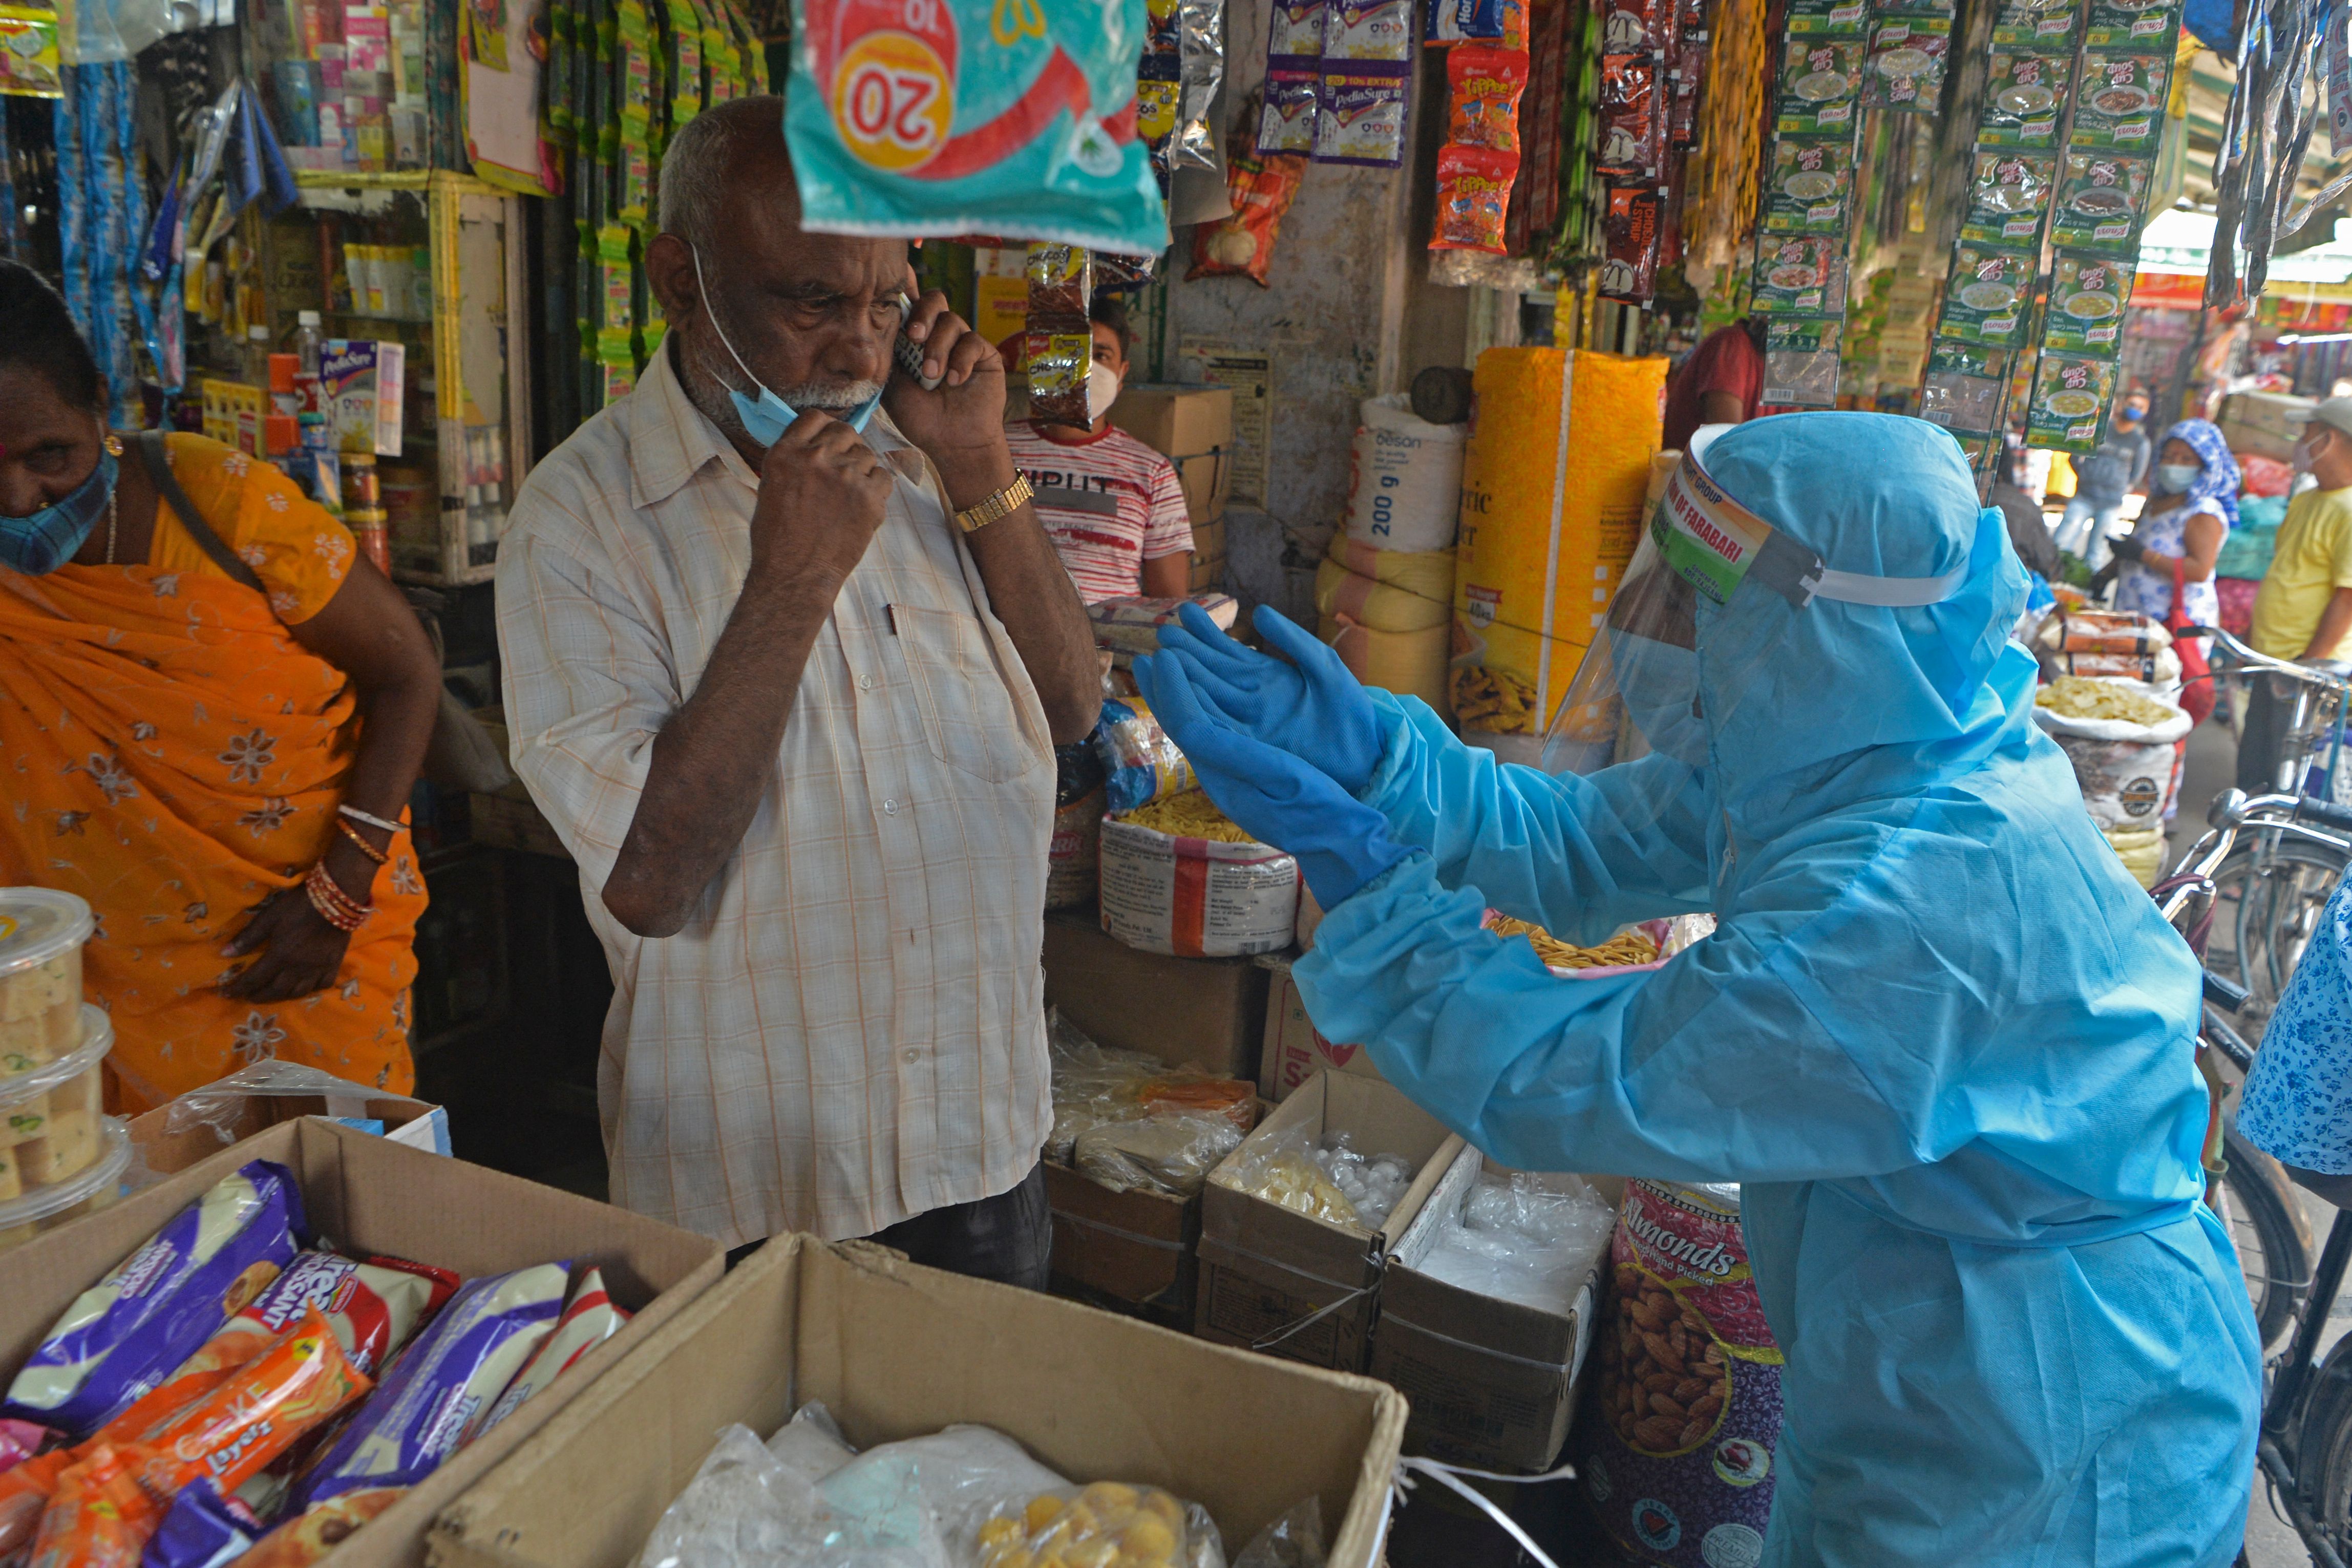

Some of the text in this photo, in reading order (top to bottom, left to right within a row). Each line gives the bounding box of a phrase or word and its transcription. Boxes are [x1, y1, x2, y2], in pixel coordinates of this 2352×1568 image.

[1831, 7, 1860, 18] Knorr
[2039, 19, 2070, 31] Knorr
[2133, 19, 2165, 31] Knorr
[1879, 30, 1908, 40] Knorr
[1808, 47, 1833, 61] Soup
[1812, 59, 1833, 72] Cup
[2013, 59, 2041, 74] Soup
[2107, 60, 2135, 74] Soup
[2017, 72, 2039, 84] Cup
[2112, 73, 2134, 84] Cup
[1335, 88, 1390, 107] PediaSure
[1890, 90, 1916, 102] Soup
[848, 64, 938, 146] 20
[1820, 109, 1848, 120] Knorr
[2023, 123, 2052, 133] Knorr
[2116, 124, 2147, 135] Knorr
[1797, 147, 1823, 162] Soup
[1801, 158, 1823, 171] Cup
[1998, 161, 2024, 175] Soup
[2001, 173, 2024, 184] Cup
[1809, 207, 1837, 218] Knorr
[1630, 208, 1643, 243] SYRUP
[2006, 222, 2035, 232] Knorr
[2097, 227, 2127, 237] Knorr
[1780, 240, 1805, 255] Soup
[1784, 252, 1804, 264] Cup
[1981, 270, 2003, 281] Cup
[2079, 266, 2106, 280] Soup
[2083, 279, 2105, 290] Cup
[1984, 320, 2015, 330] Knorr
[2089, 329, 2114, 338] Knorr
[2062, 366, 2087, 379] Soup
[2065, 377, 2086, 389] Cup
[1381, 475, 1401, 488] g
[1694, 476, 1723, 505] GROUP
[1372, 495, 1394, 537] 200
[1674, 494, 1689, 517] OF
[1683, 506, 1744, 564] FARABARI
[1622, 1196, 1737, 1277] Almonds
[1649, 1249, 1674, 1270] Hand
[1676, 1263, 1714, 1287] Picked
